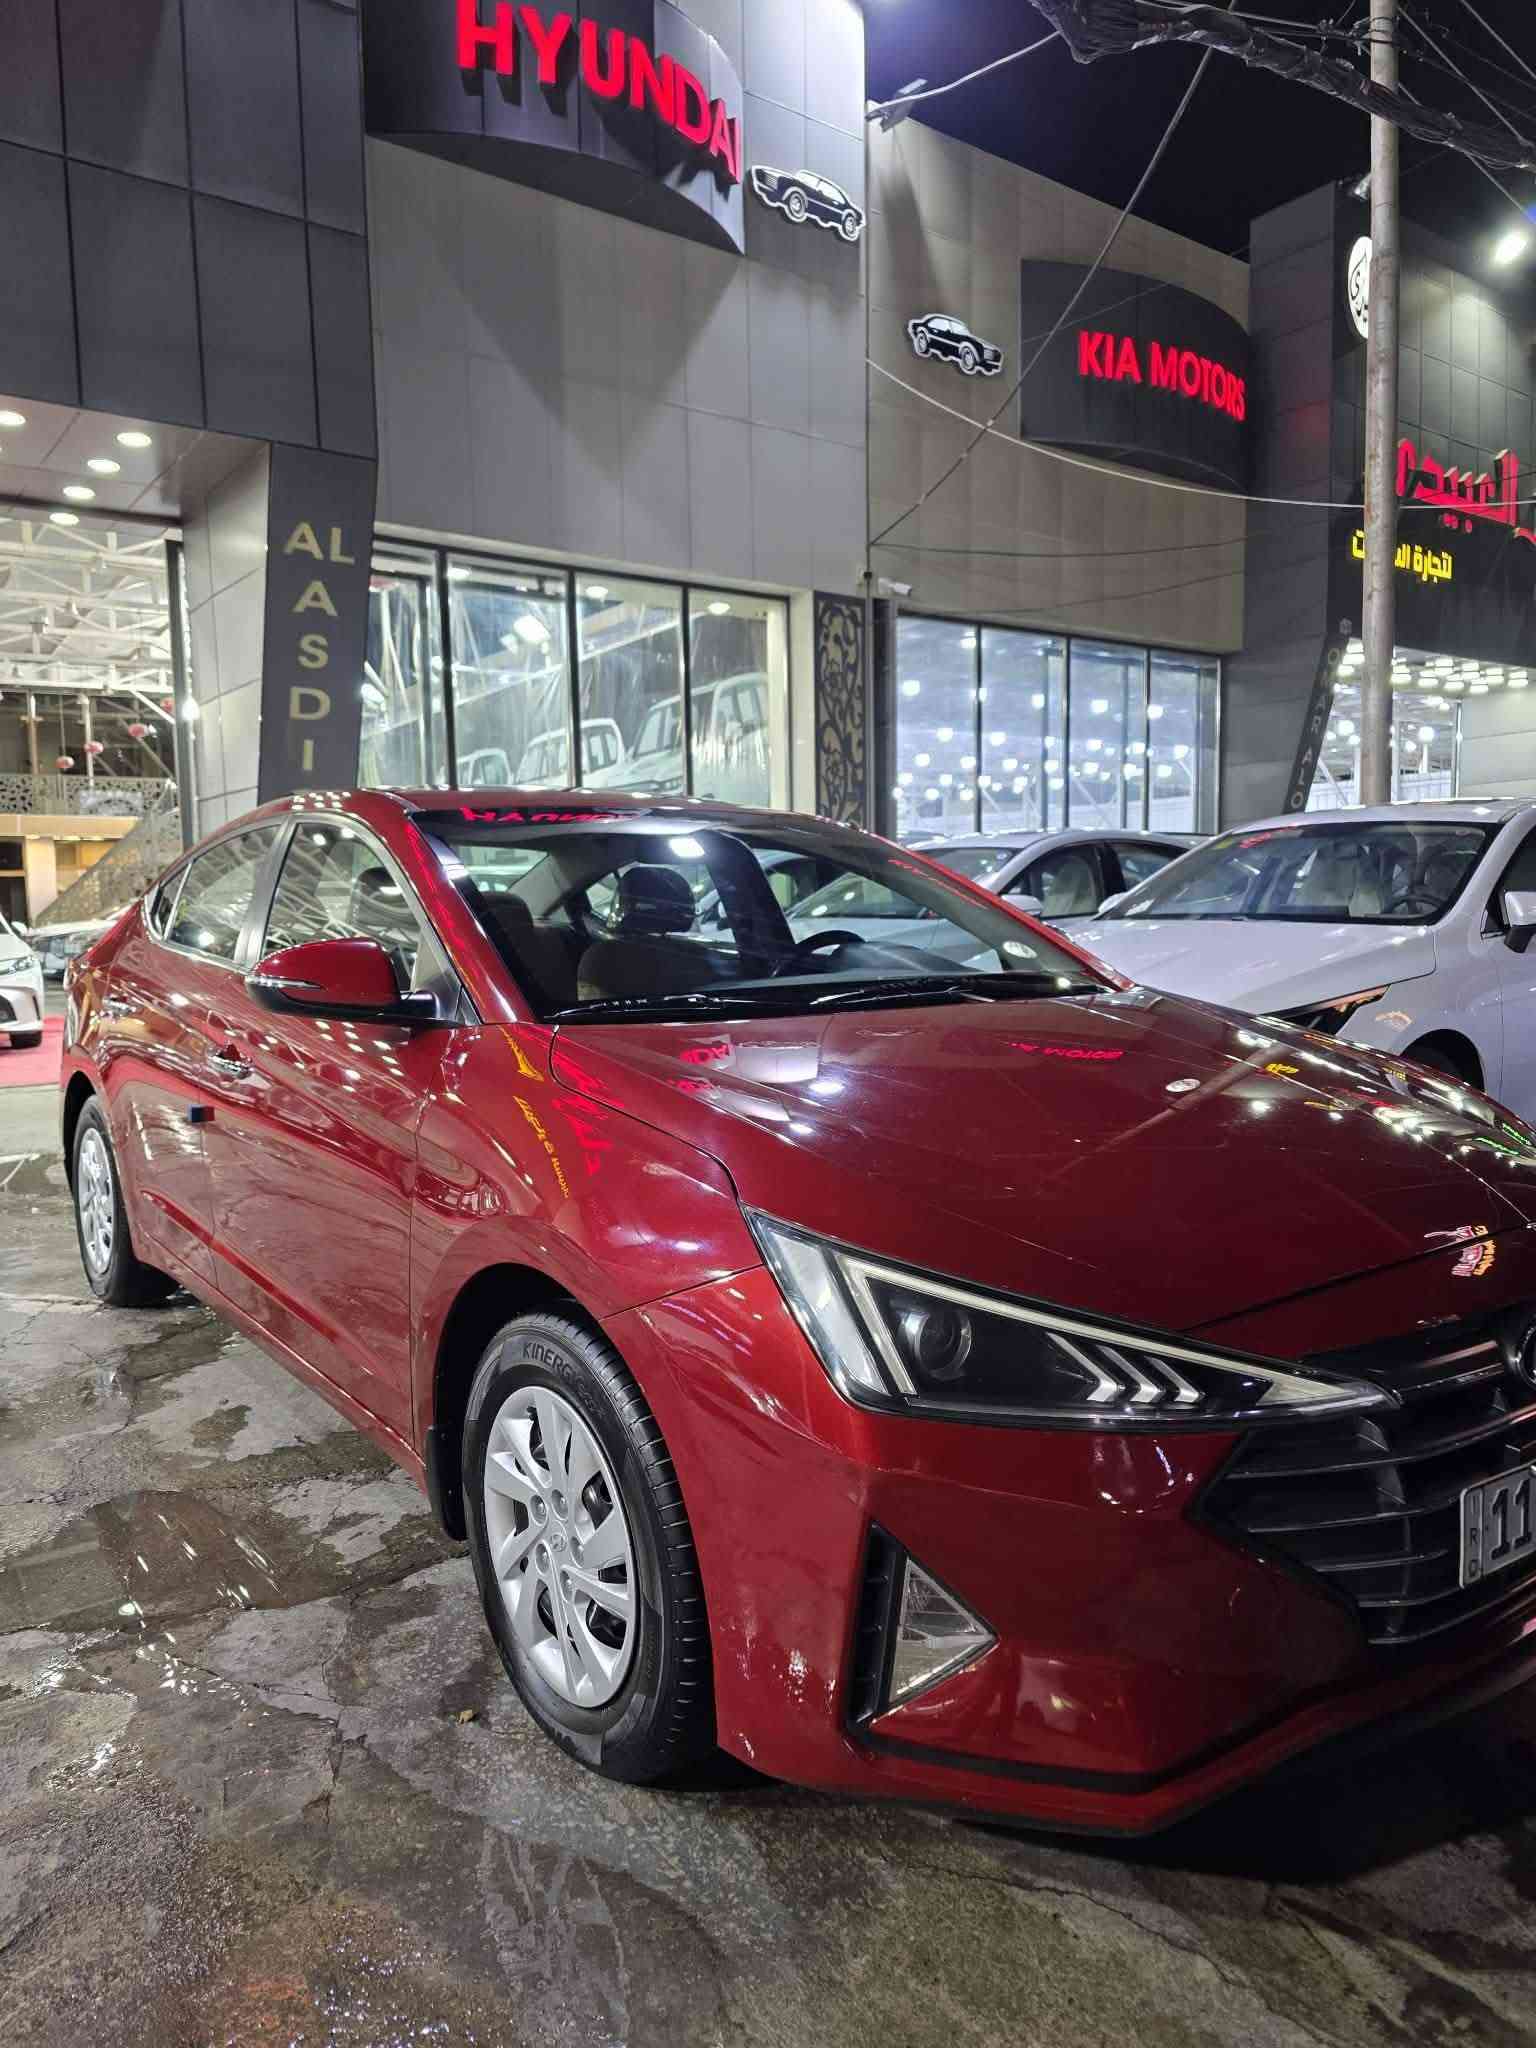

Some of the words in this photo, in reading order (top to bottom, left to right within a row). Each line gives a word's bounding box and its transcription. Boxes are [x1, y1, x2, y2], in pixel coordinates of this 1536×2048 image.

[456, 0, 742, 185] HYUNDAI
[1078, 329, 1142, 385] KIA
[1151, 341, 1247, 422] MOTORS
[284, 521, 357, 566] AL
